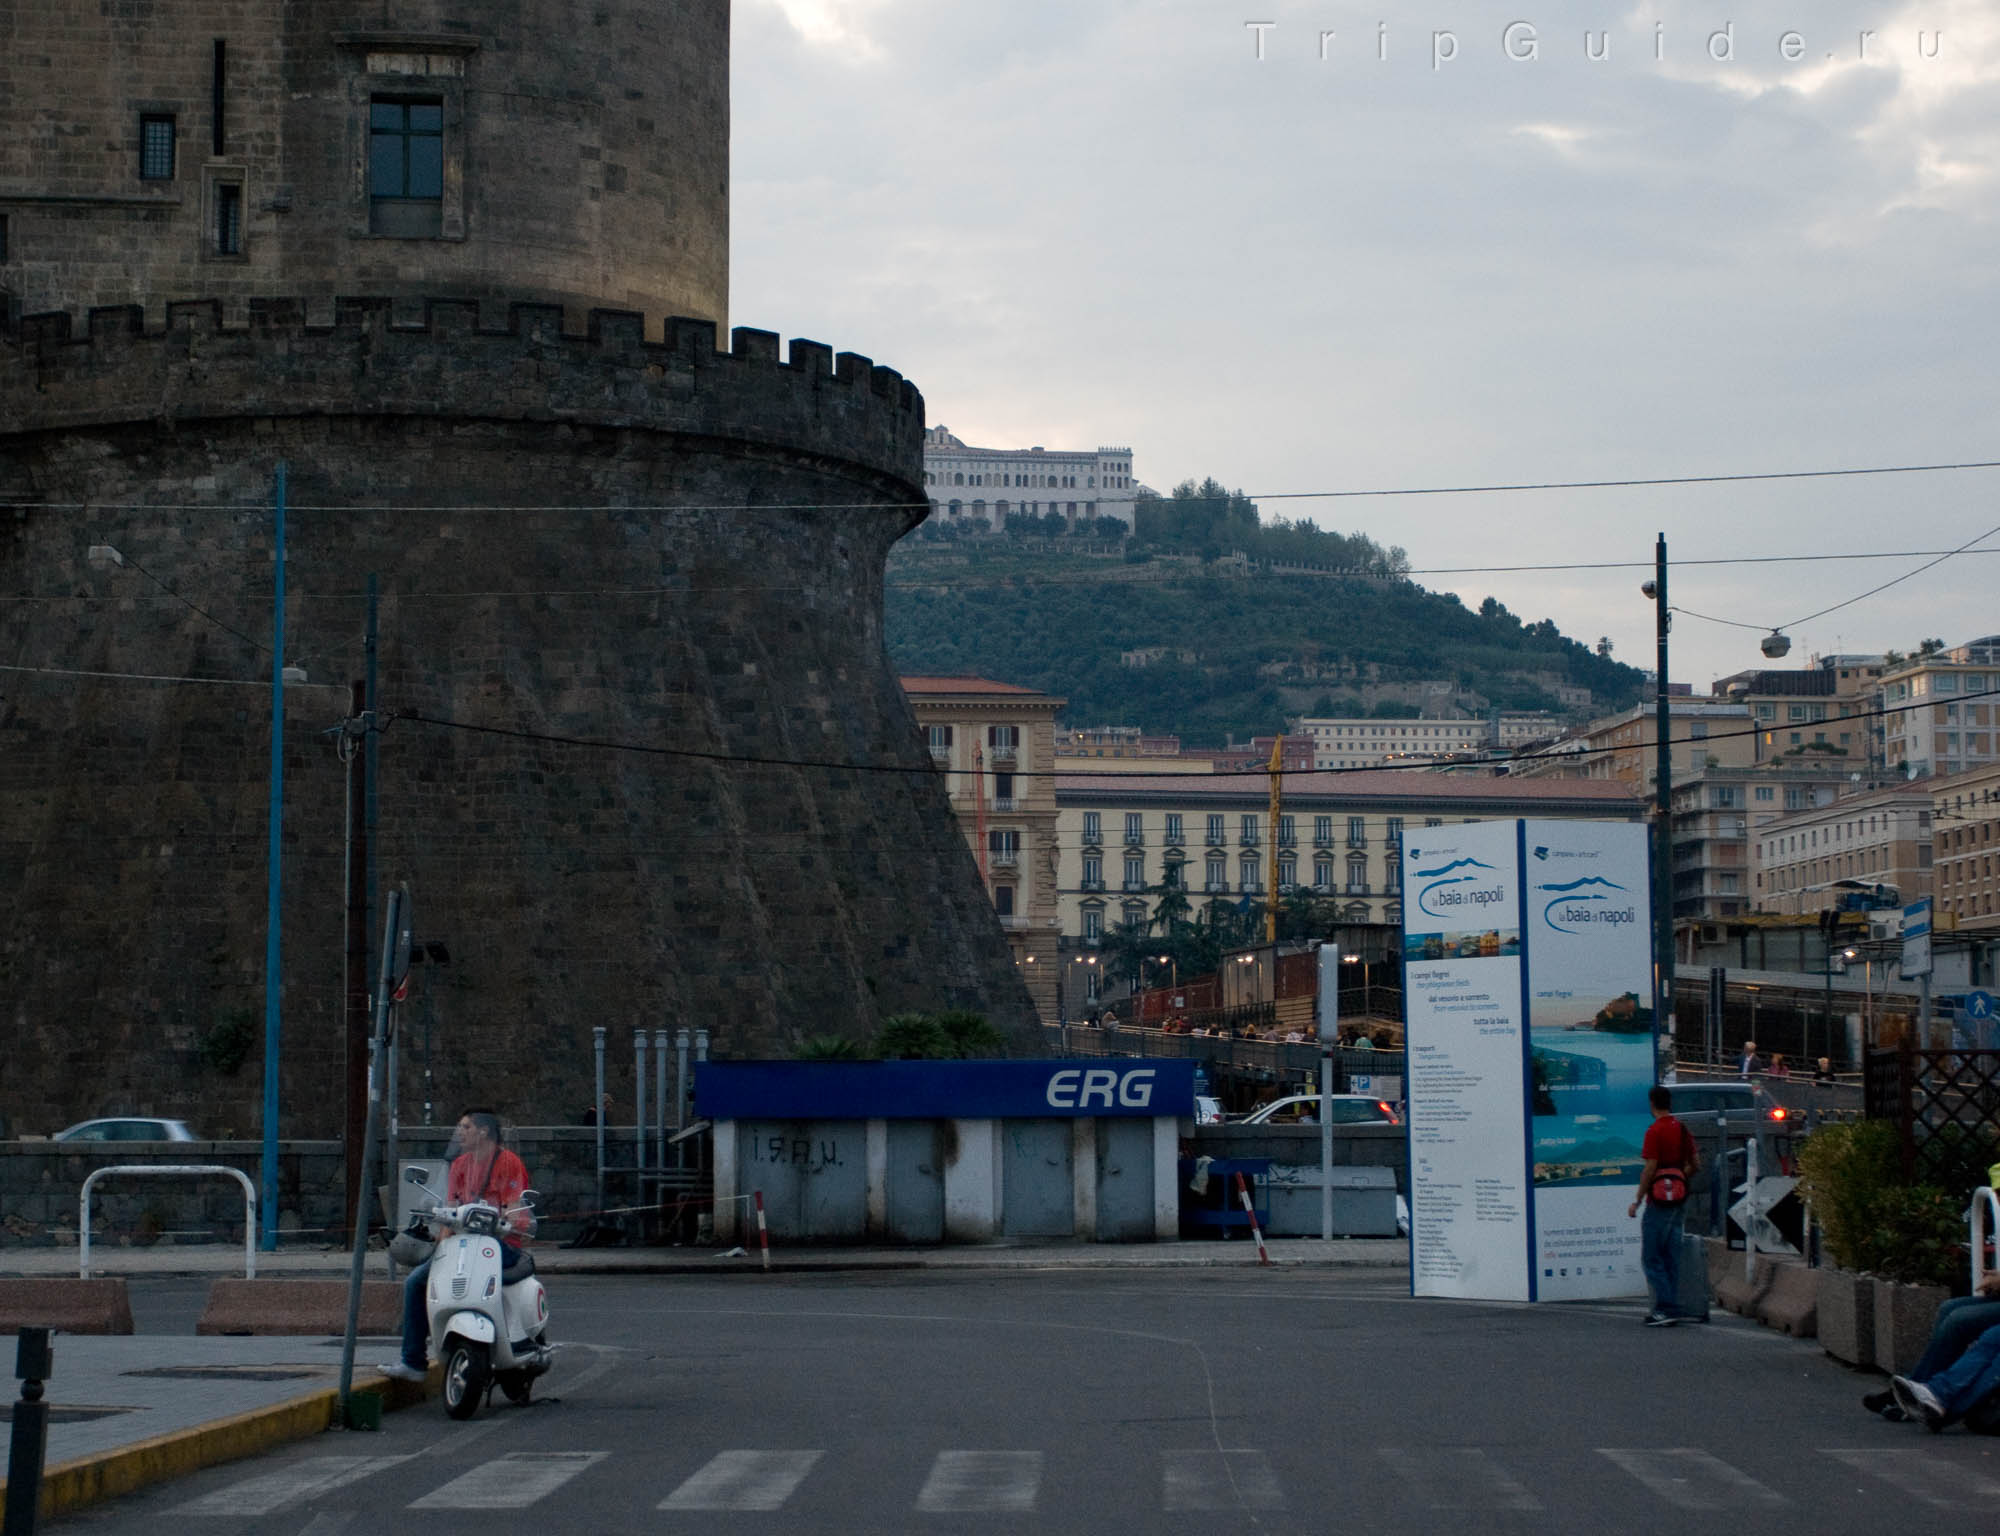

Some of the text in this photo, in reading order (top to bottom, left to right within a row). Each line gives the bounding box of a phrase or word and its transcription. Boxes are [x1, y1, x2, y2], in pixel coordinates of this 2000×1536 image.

[1439, 888, 1462, 906] baia
[1470, 885, 1504, 908] napoli
[1566, 905, 1591, 922] baia
[1600, 907, 1635, 927] napoli
[1046, 1069, 1156, 1108] ERG
